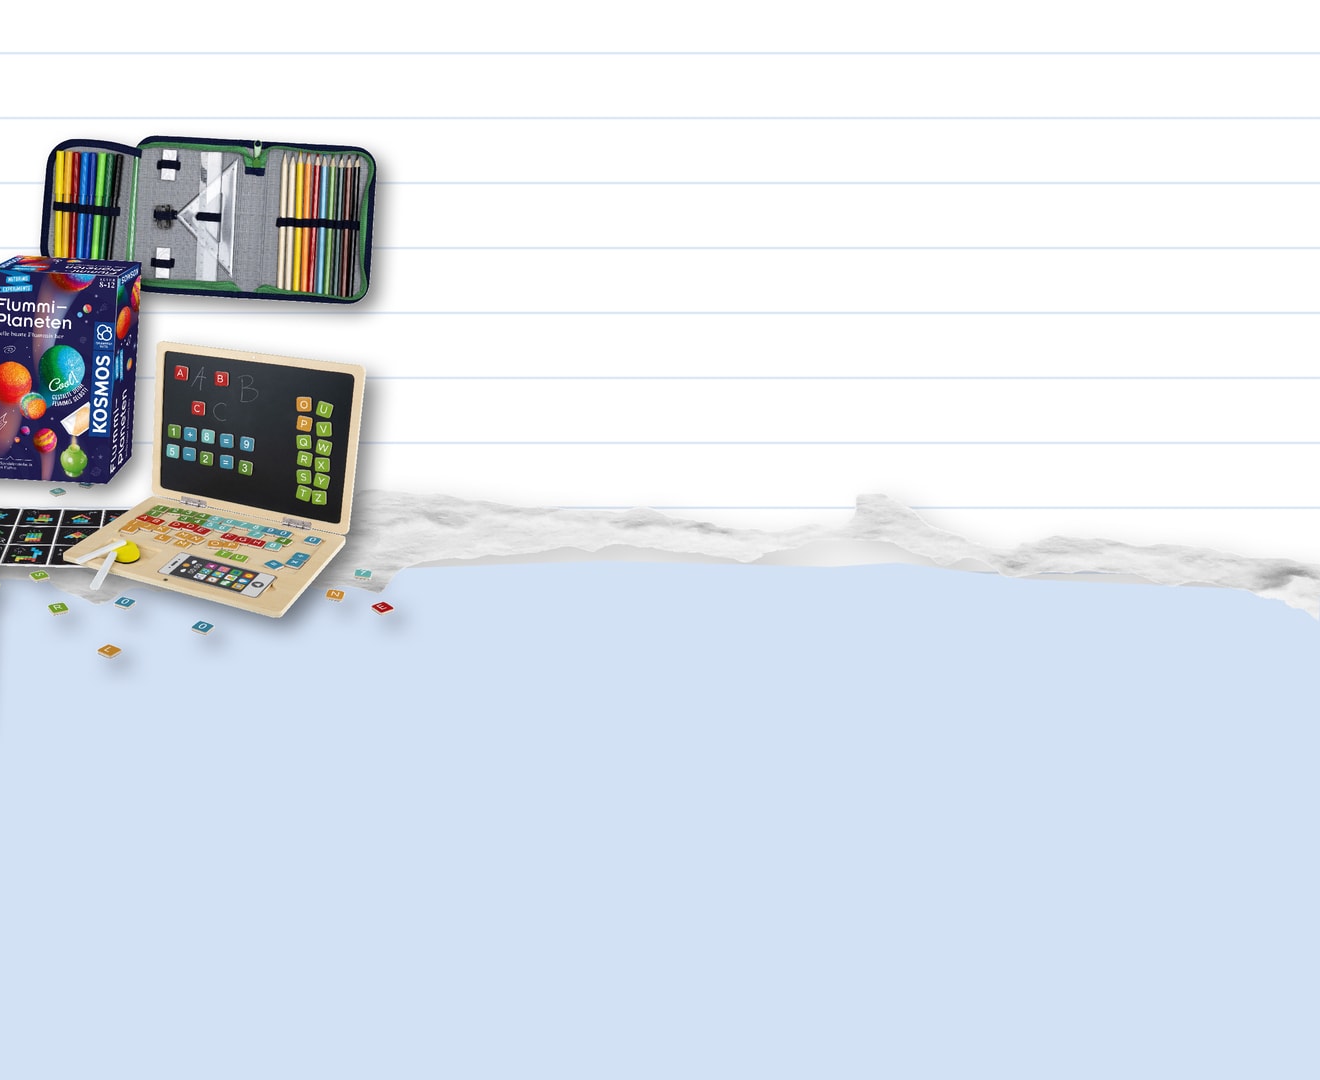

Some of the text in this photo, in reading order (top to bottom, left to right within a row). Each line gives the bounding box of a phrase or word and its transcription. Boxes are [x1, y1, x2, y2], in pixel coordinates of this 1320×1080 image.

[191, 366, 207, 391] A
[238, 374, 259, 403] B
[92, 355, 110, 433] KOSMOS
[213, 402, 228, 422] C
